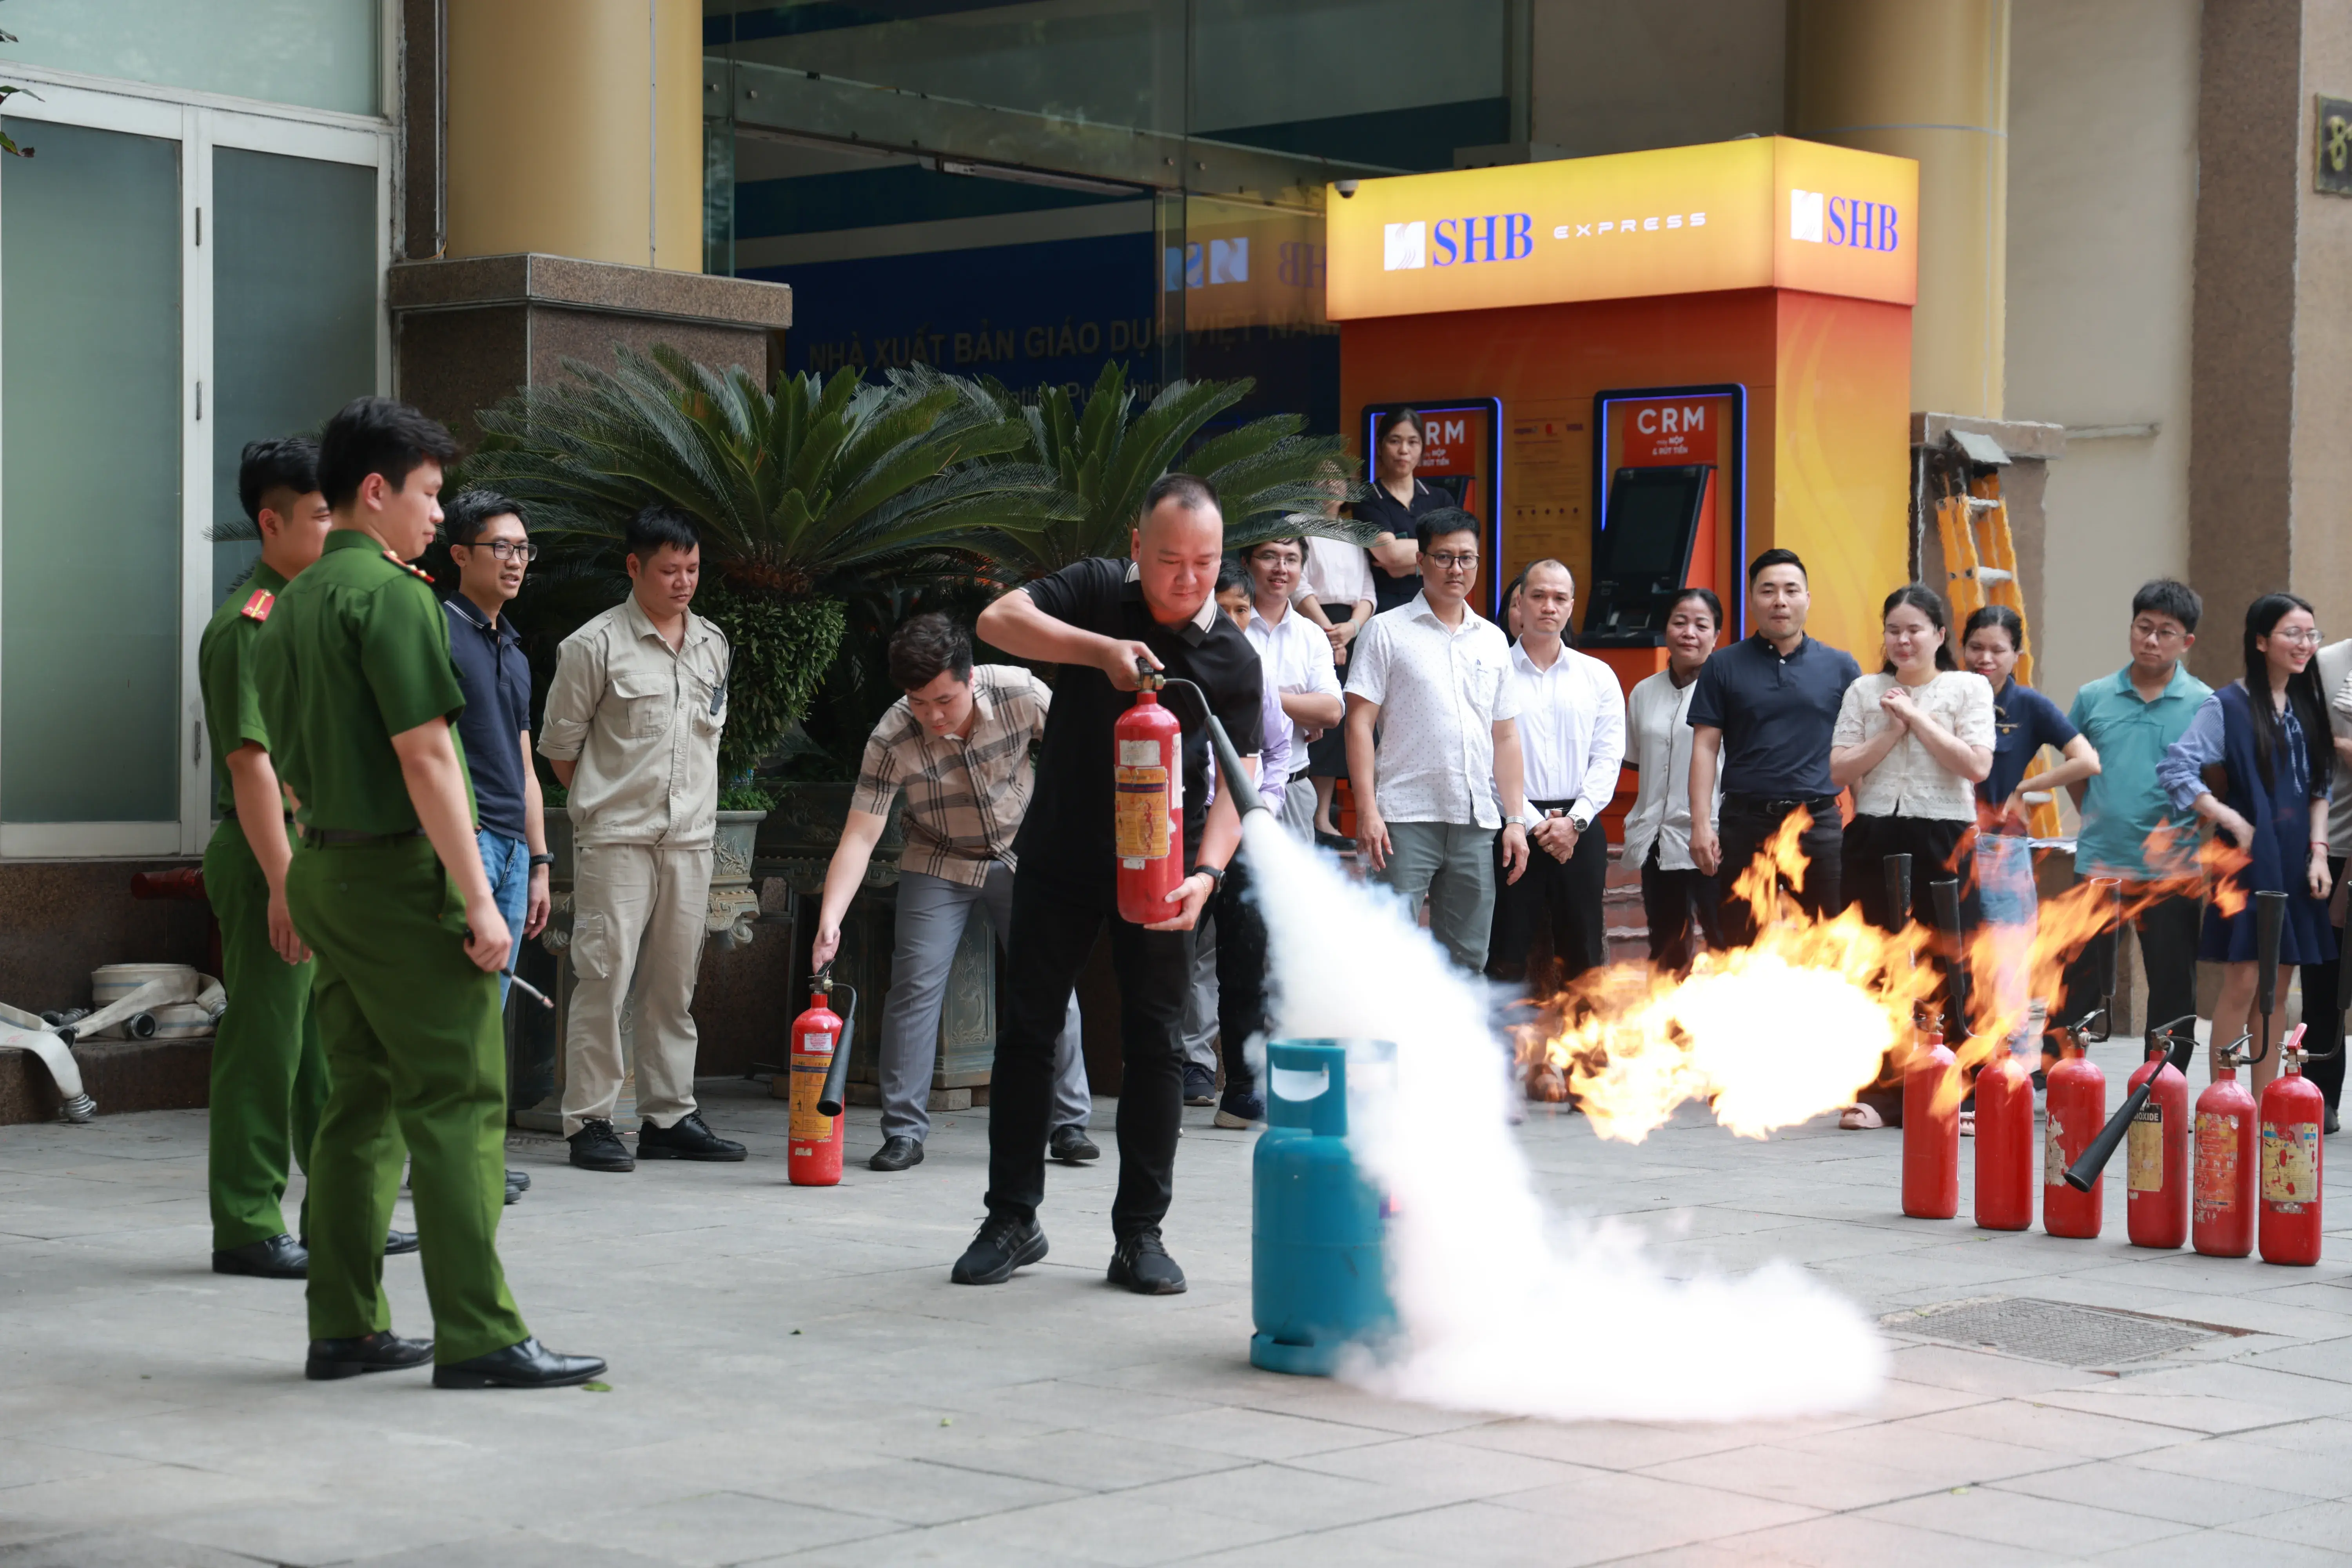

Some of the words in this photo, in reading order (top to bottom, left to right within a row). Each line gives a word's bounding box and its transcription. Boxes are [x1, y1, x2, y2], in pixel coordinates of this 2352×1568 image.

[2327, 115, 2352, 171] 8
[1433, 212, 1535, 267] SHB
[1553, 212, 1706, 239] EXPRESS
[1827, 196, 1898, 252] SHB
[809, 331, 867, 372] NHÀ
[873, 321, 946, 369] XUẤT
[954, 318, 1015, 363] BẢN
[1024, 315, 1100, 358] GIÁO
[1110, 316, 1176, 358] DỤC
[1426, 420, 1465, 445] RM
[1637, 406, 1704, 434] CRM
